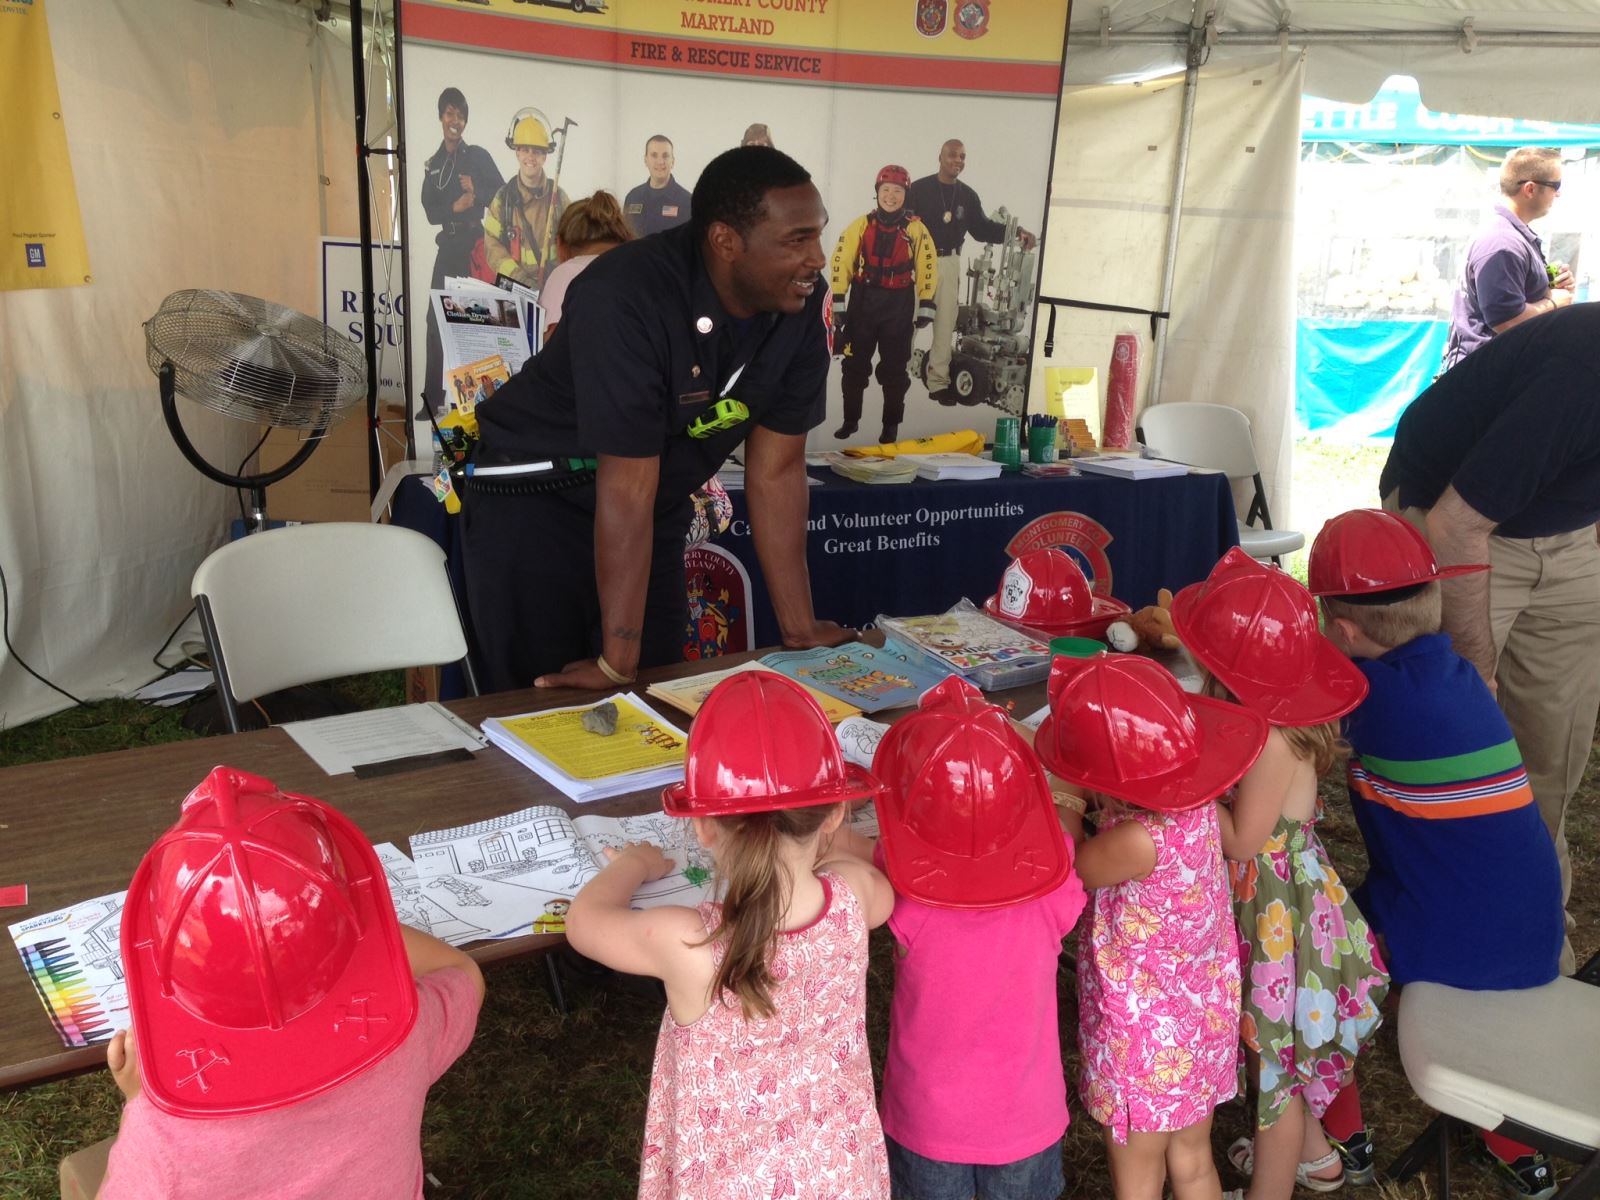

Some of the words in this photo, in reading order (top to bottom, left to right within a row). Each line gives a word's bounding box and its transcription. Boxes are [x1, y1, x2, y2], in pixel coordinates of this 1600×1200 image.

[680, 11, 775, 36] MARYLAND
[631, 41, 667, 60] FIRE
[671, 46, 682, 62] &
[687, 47, 750, 68] RESCUE
[754, 56, 822, 74] SERVICE
[29, 248, 41, 259] GM
[922, 233, 933, 290] RESCUE
[832, 513, 911, 528] Volunteer
[915, 502, 1024, 526] Opportunities
[824, 538, 871, 554] Great
[877, 532, 940, 550] Benefits
